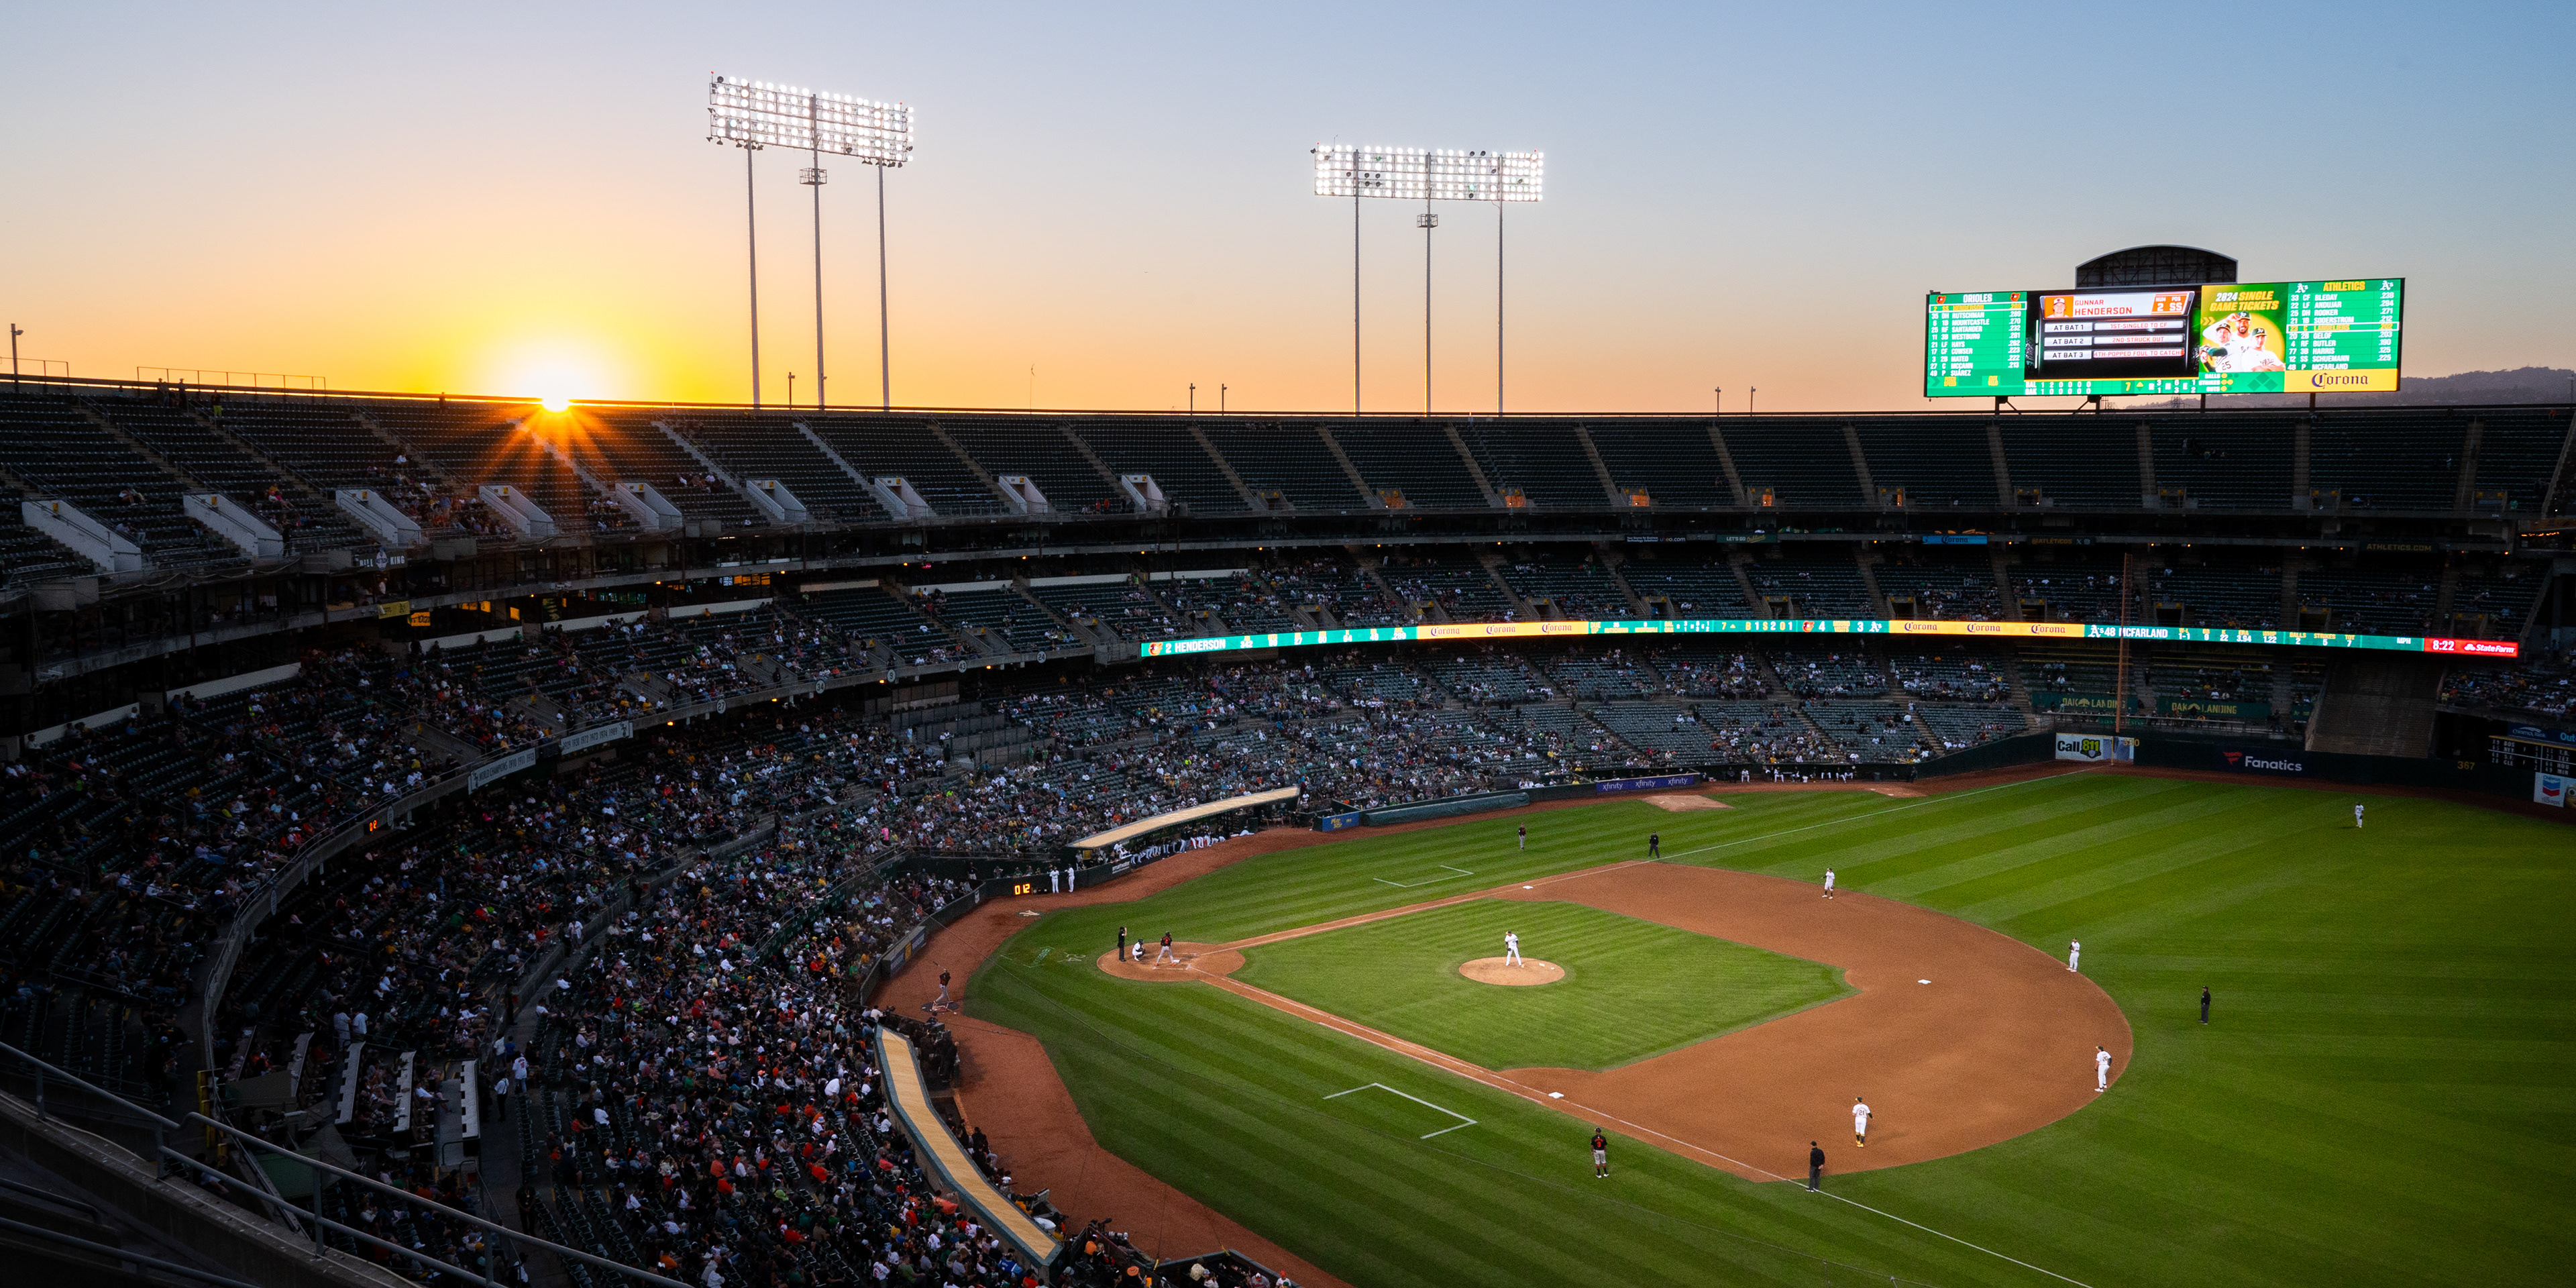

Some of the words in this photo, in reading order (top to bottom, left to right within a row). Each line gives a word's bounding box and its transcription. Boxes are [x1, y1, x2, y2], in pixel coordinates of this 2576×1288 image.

[2323, 281, 2365, 291] ATHLETICS
[1963, 294, 1992, 303] ORIOLES
[2215, 292, 2238, 302] 2024
[2239, 290, 2274, 301] SINGLE
[2075, 307, 2132, 315] HENDERSON
[2157, 303, 2163, 311] 2
[2169, 303, 2182, 311] SS
[2210, 302, 2238, 311] GAME
[2239, 301, 2279, 311] TICKETS
[2222, 361, 2231, 370] 25
[2312, 372, 2368, 389] Corona
[2125, 382, 2131, 391] 7
[1941, 535, 1968, 544] Corona
[2366, 543, 2432, 551] ATHLETICS.COM
[390, 555, 405, 565] KING
[1486, 625, 1515, 636] Corona
[1542, 623, 1572, 634] Corona
[1721, 622, 1727, 630] 7
[1746, 621, 1752, 631] B
[1755, 621, 1759, 630] 1
[1762, 621, 1768, 631] S
[1770, 621, 1776, 630] 2
[1788, 621, 1792, 630] 1
[1819, 621, 1825, 631] 4
[1857, 621, 1864, 631] 3
[1904, 622, 1937, 632] Corona
[1967, 623, 2000, 633] Corona
[2031, 624, 2065, 635] Corona
[1431, 627, 1460, 637] Corona
[2104, 627, 2115, 637] 48
[2118, 628, 2167, 638] MCFARLAND
[1166, 643, 1172, 653] 2
[1175, 639, 1226, 653] HENDERSON
[2432, 640, 2455, 651] 8:22
[2062, 698, 2078, 706] OAK
[2171, 703, 2187, 711] OAK
[2057, 741, 2080, 751] Call
[2082, 739, 2100, 751] 811
[2123, 739, 2140, 747] 330
[2245, 756, 2302, 771] Fanatics
[2457, 761, 2475, 770] 367
[1603, 783, 1623, 791] xfinity
[1635, 780, 1656, 788] xfinity
[1668, 777, 1688, 786] xfinity
